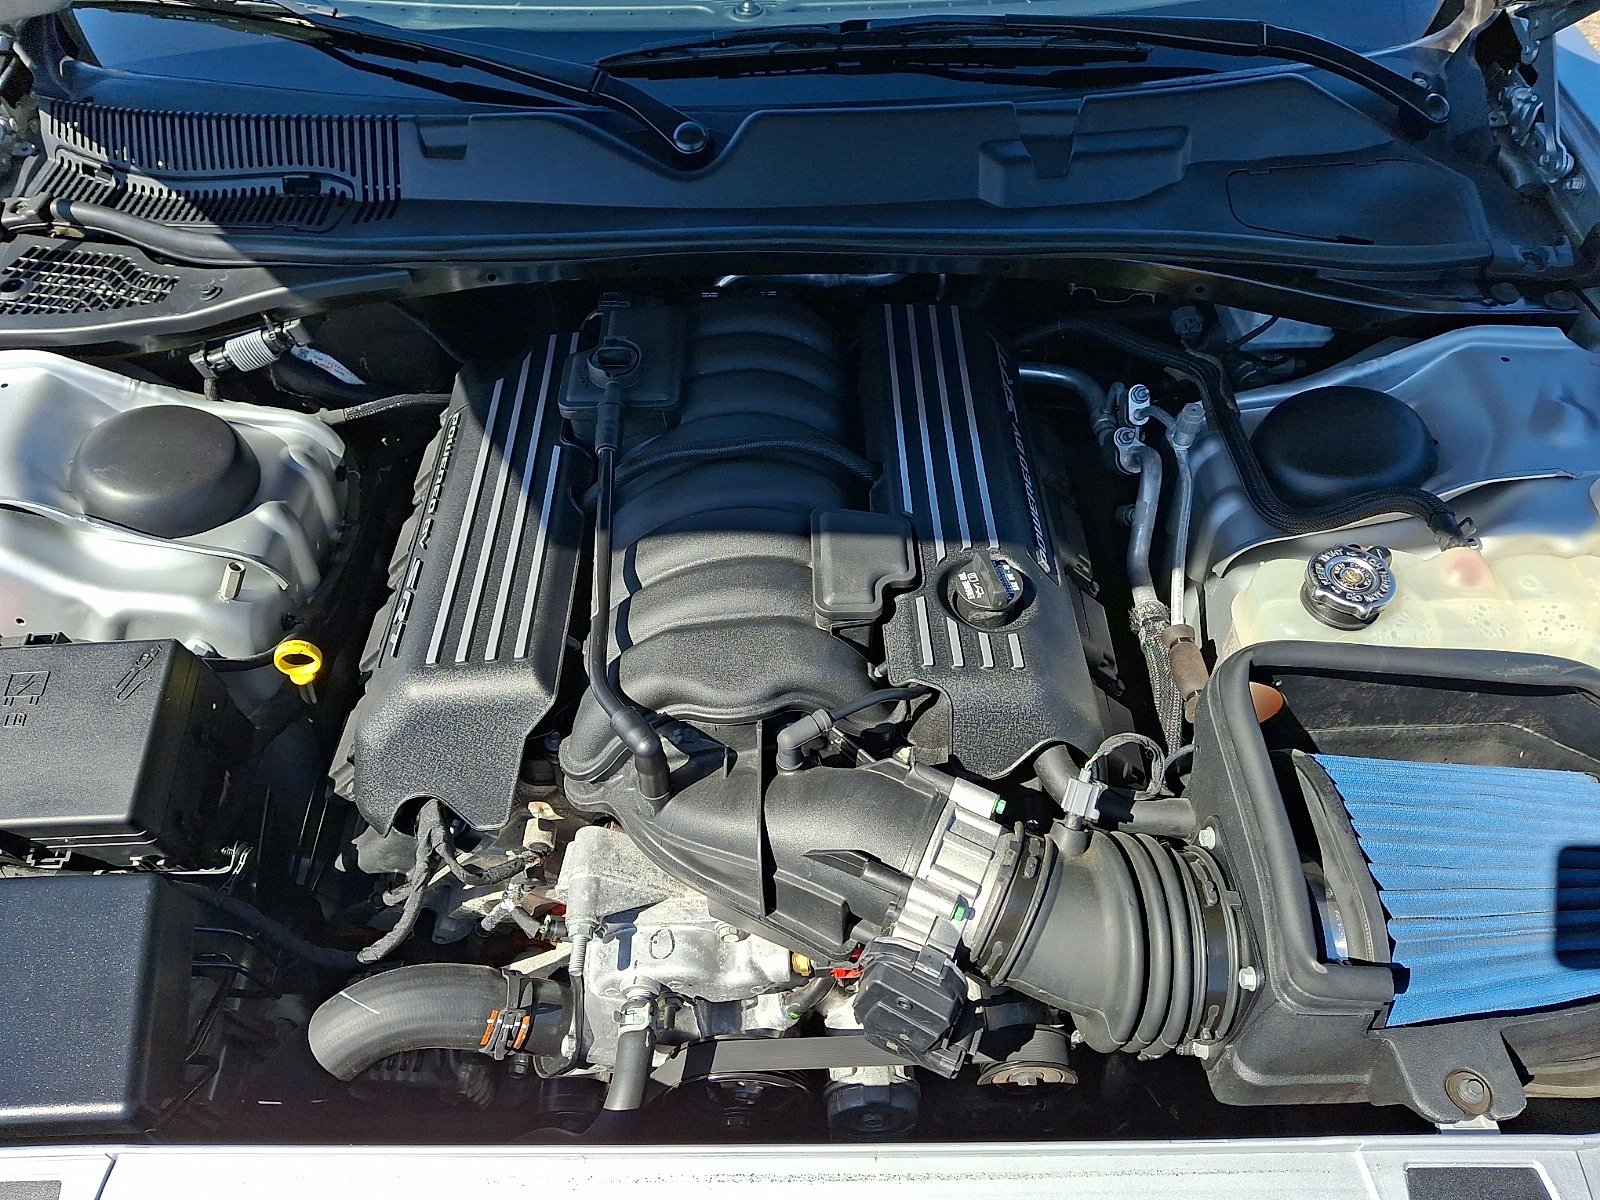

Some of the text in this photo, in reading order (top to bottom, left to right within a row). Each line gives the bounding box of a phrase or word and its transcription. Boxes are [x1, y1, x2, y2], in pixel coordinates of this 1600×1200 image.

[390, 412, 461, 658] POWERED BY SRT
[991, 338, 1051, 573] POWERED BY SRT
